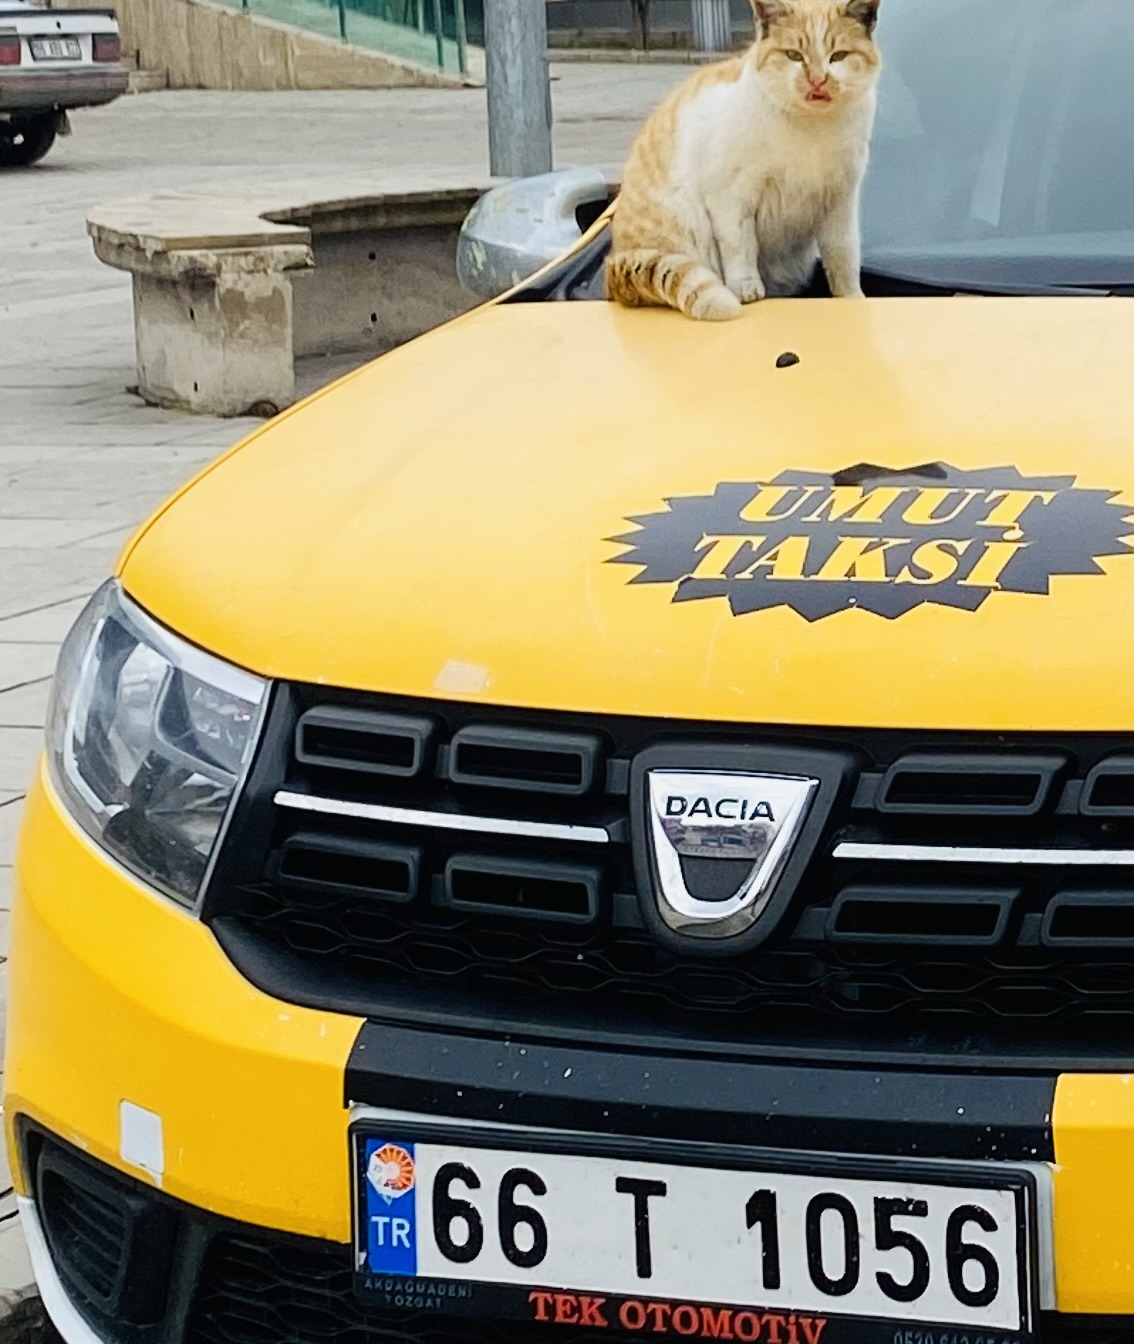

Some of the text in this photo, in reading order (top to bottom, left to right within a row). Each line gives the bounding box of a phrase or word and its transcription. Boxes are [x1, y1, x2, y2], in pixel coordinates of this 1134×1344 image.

[738, 484, 1060, 528] UMUT
[665, 795, 775, 822] DACIA
[371, 1216, 411, 1249] TR
[432, 1161, 548, 1269] 66
[615, 1176, 667, 1279] T
[745, 1188, 1000, 1308] 1056
[528, 1290, 608, 1328] TEK
